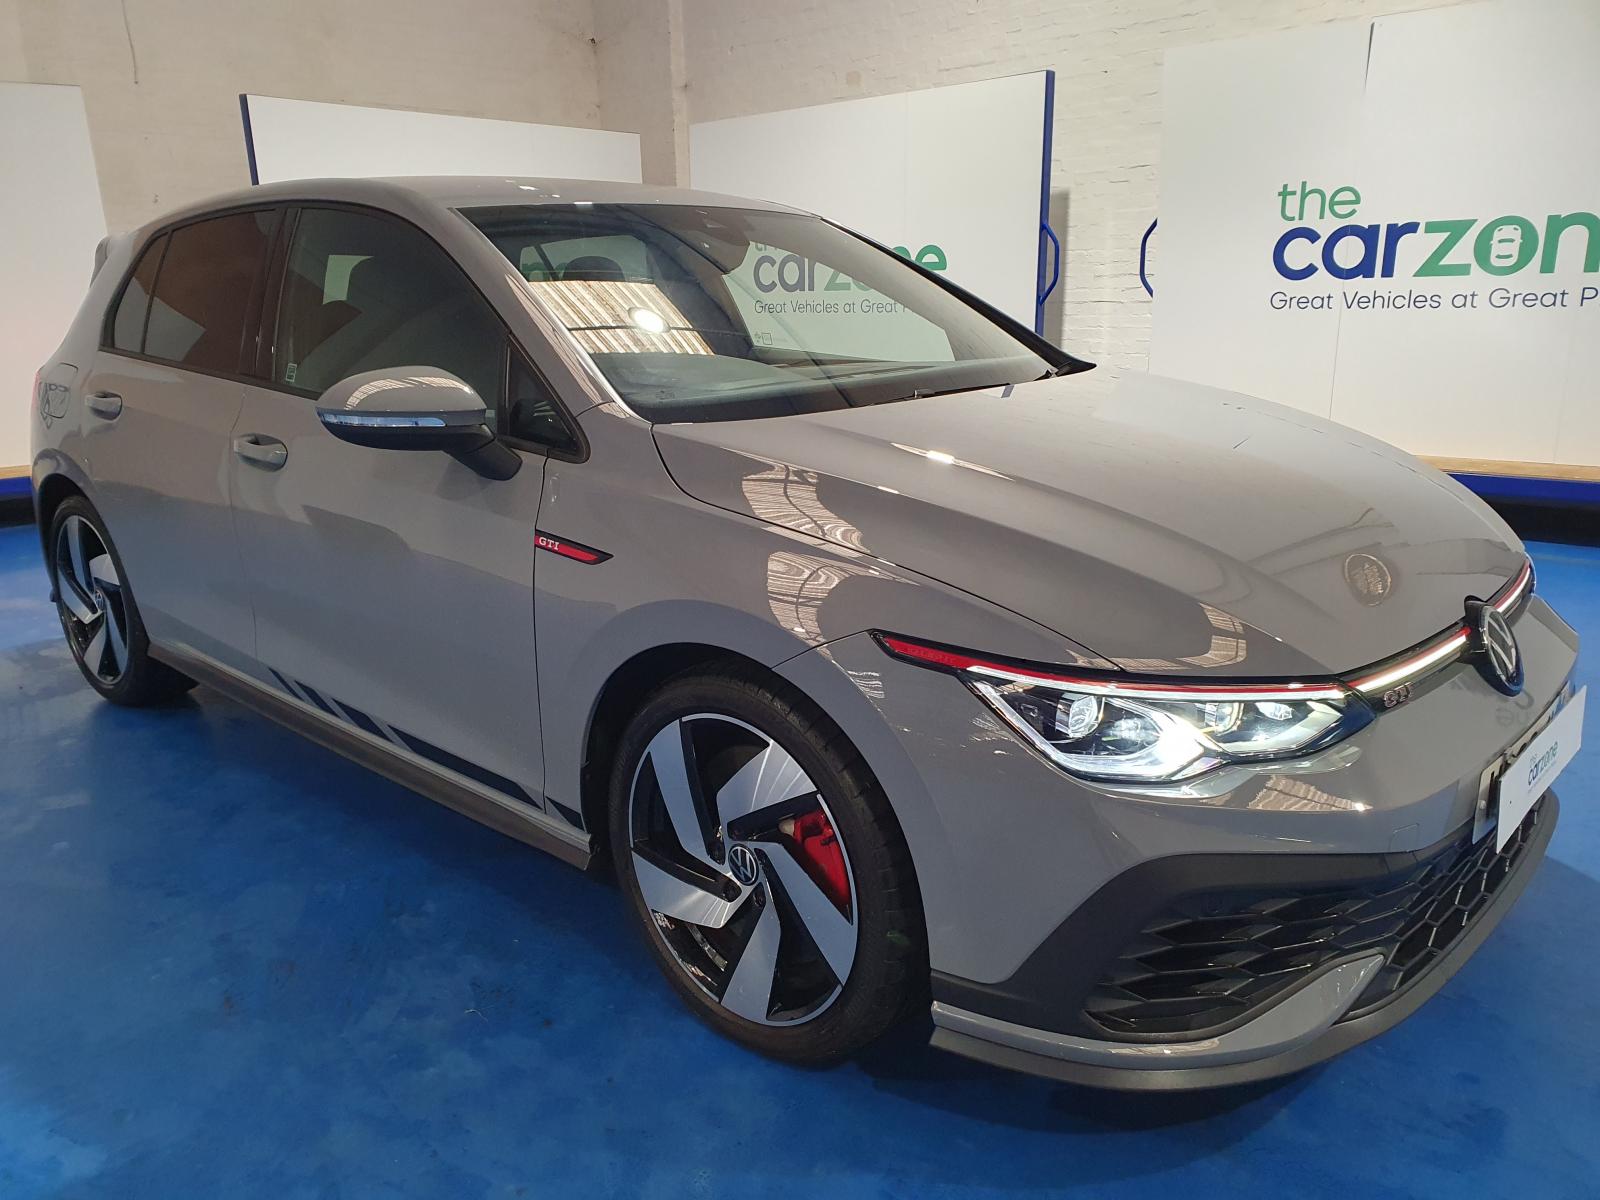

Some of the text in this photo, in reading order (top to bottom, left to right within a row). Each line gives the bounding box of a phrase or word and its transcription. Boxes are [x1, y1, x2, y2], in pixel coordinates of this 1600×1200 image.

[1278, 180, 1361, 221] the
[754, 300, 787, 314] Great
[790, 299, 840, 314] Vehicles
[843, 300, 856, 314] at
[860, 299, 898, 314] Great
[1269, 290, 1334, 310] Great
[1343, 289, 1442, 310] Vehicles
[1451, 290, 1479, 309] at
[1488, 287, 1570, 309] Great
[538, 537, 560, 550] GTI
